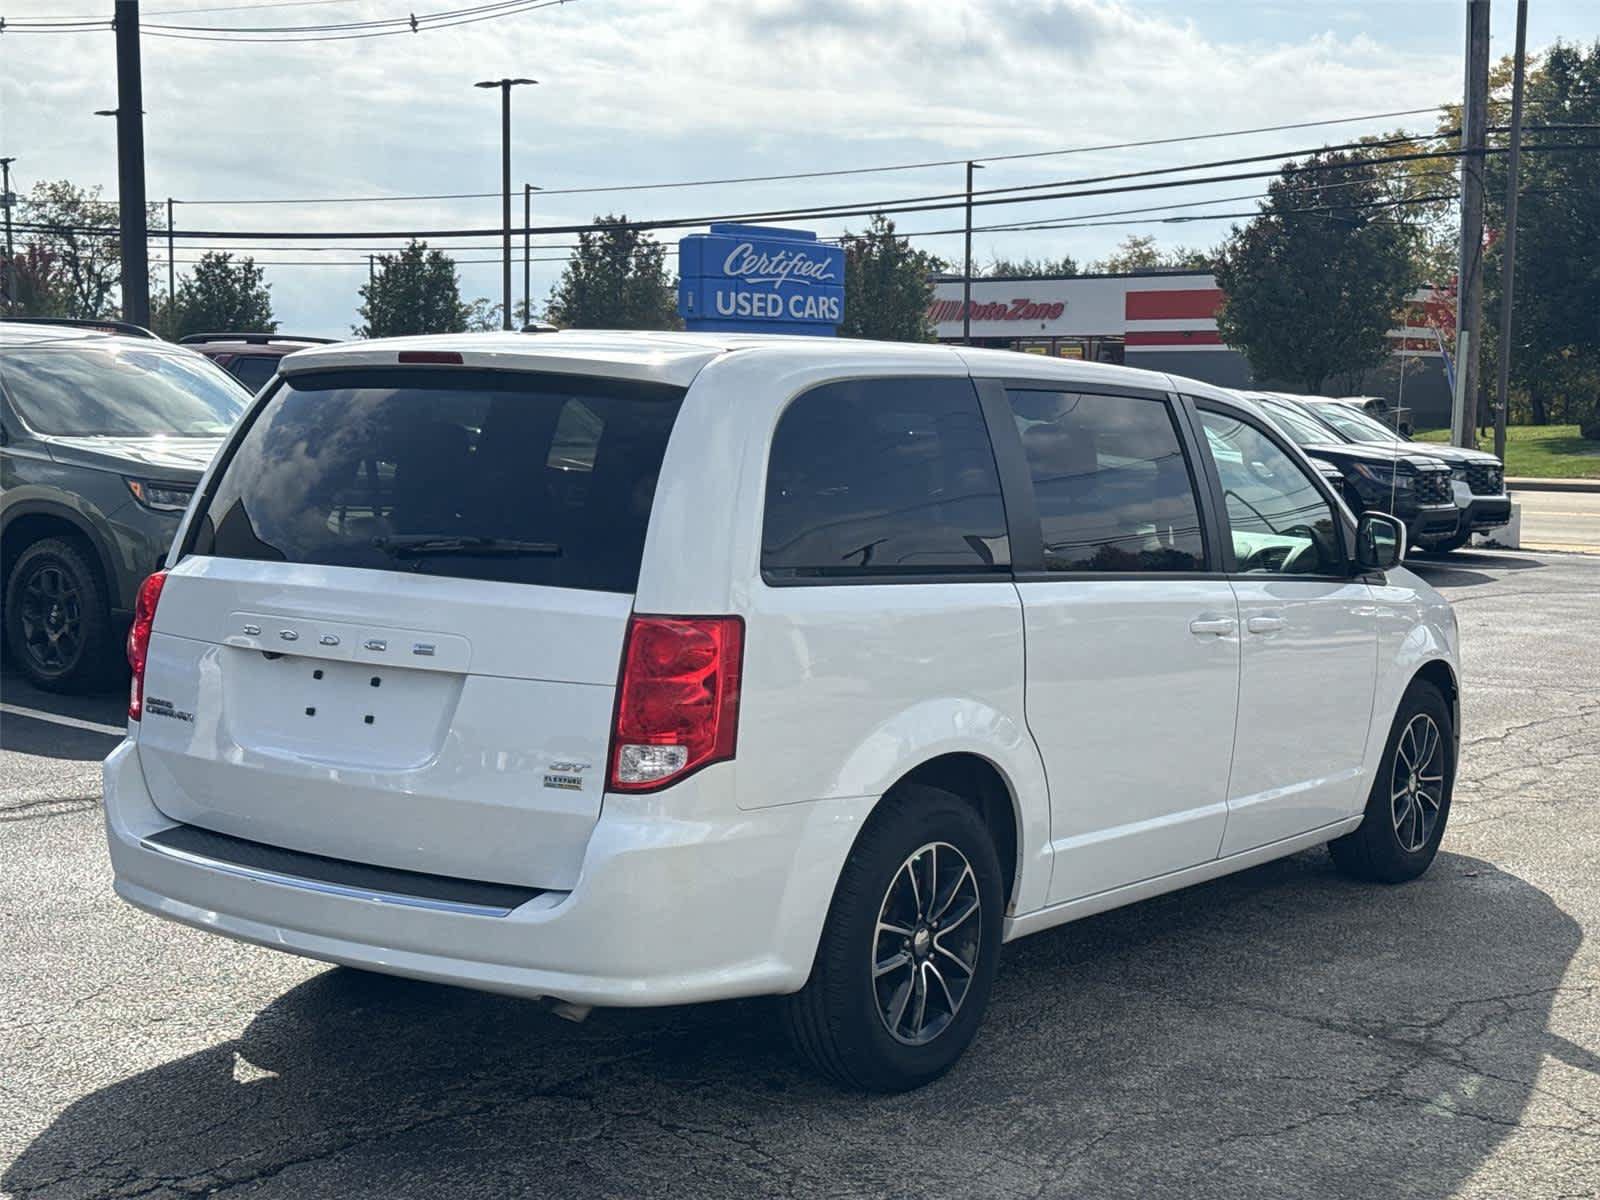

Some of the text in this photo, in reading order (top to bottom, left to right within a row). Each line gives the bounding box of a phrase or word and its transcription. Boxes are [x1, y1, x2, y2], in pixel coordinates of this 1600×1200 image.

[723, 243, 835, 289] Certified
[716, 291, 840, 319] USED CARS
[955, 298, 1065, 321] AutoZone
[242, 623, 436, 656] DODGE
